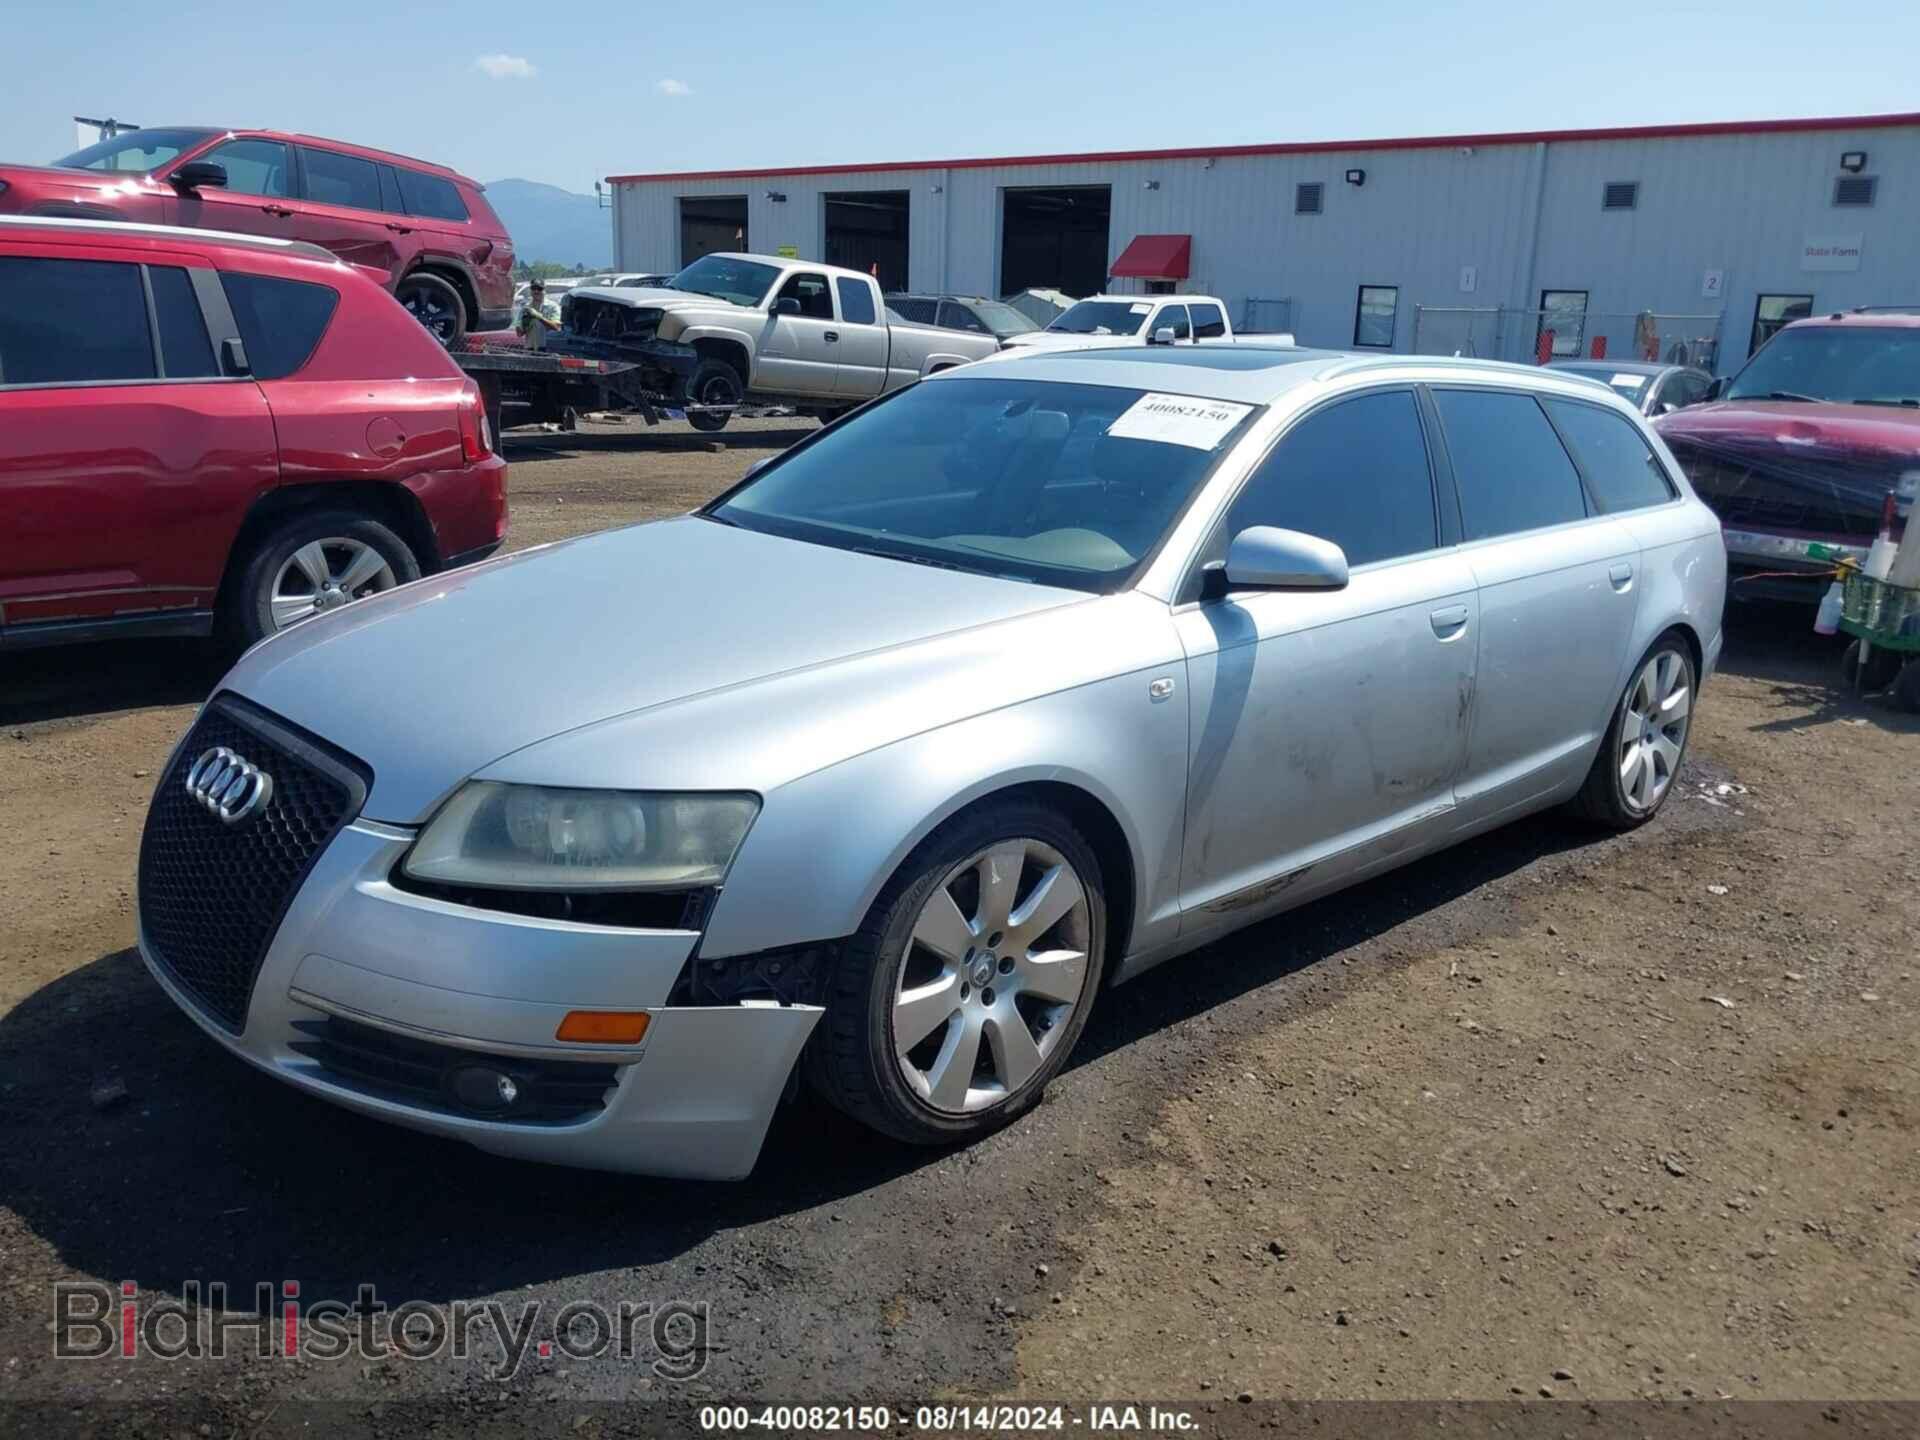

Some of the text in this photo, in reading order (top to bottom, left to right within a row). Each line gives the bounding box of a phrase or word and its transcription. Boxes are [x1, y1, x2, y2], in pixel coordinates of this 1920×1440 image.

[1832, 246, 1858, 257] Farm
[1708, 277, 1717, 290] 2
[1144, 403, 1230, 421] 40082150
